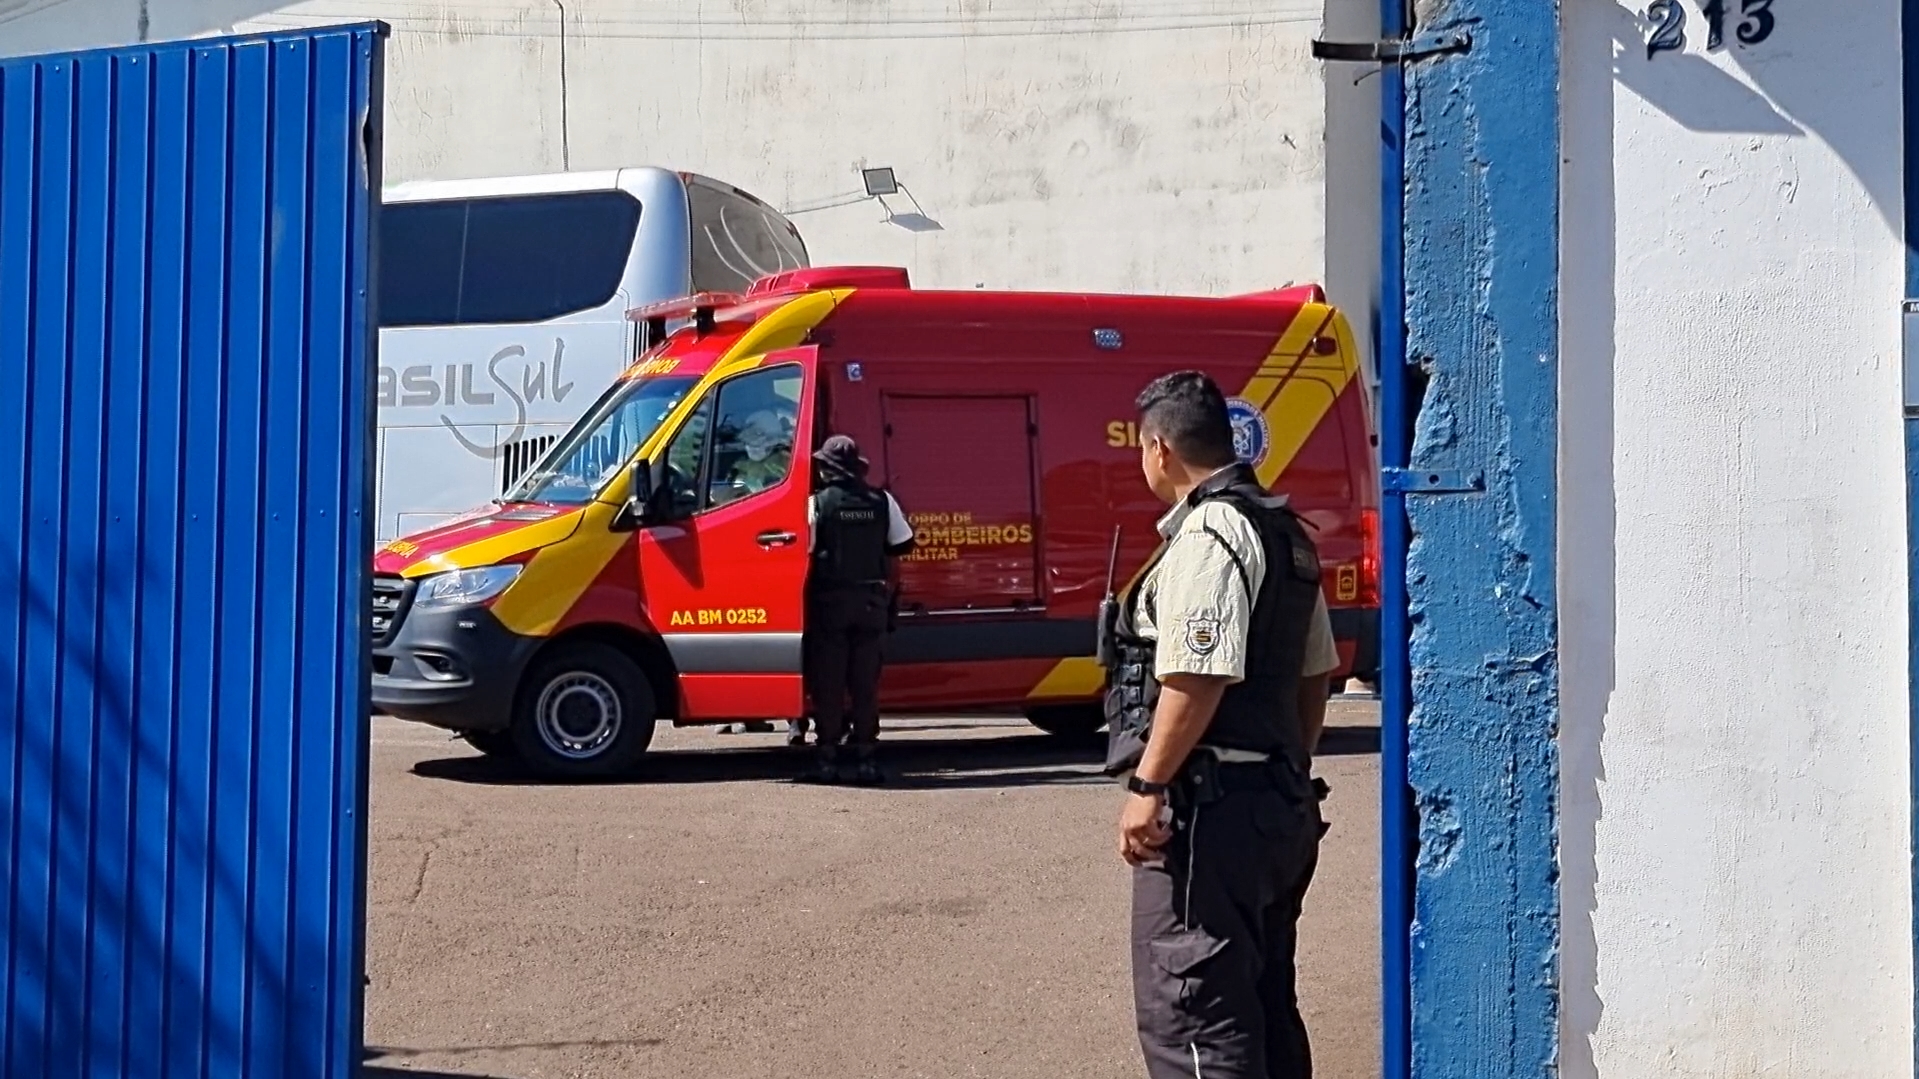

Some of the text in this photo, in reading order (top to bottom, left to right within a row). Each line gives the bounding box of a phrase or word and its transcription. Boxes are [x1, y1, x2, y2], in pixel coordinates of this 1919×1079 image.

[1107, 421, 1141, 447] SI
[908, 513, 949, 525] ORPO
[914, 524, 1033, 546] OMBEIROS
[670, 608, 767, 625] AA BM 0252
